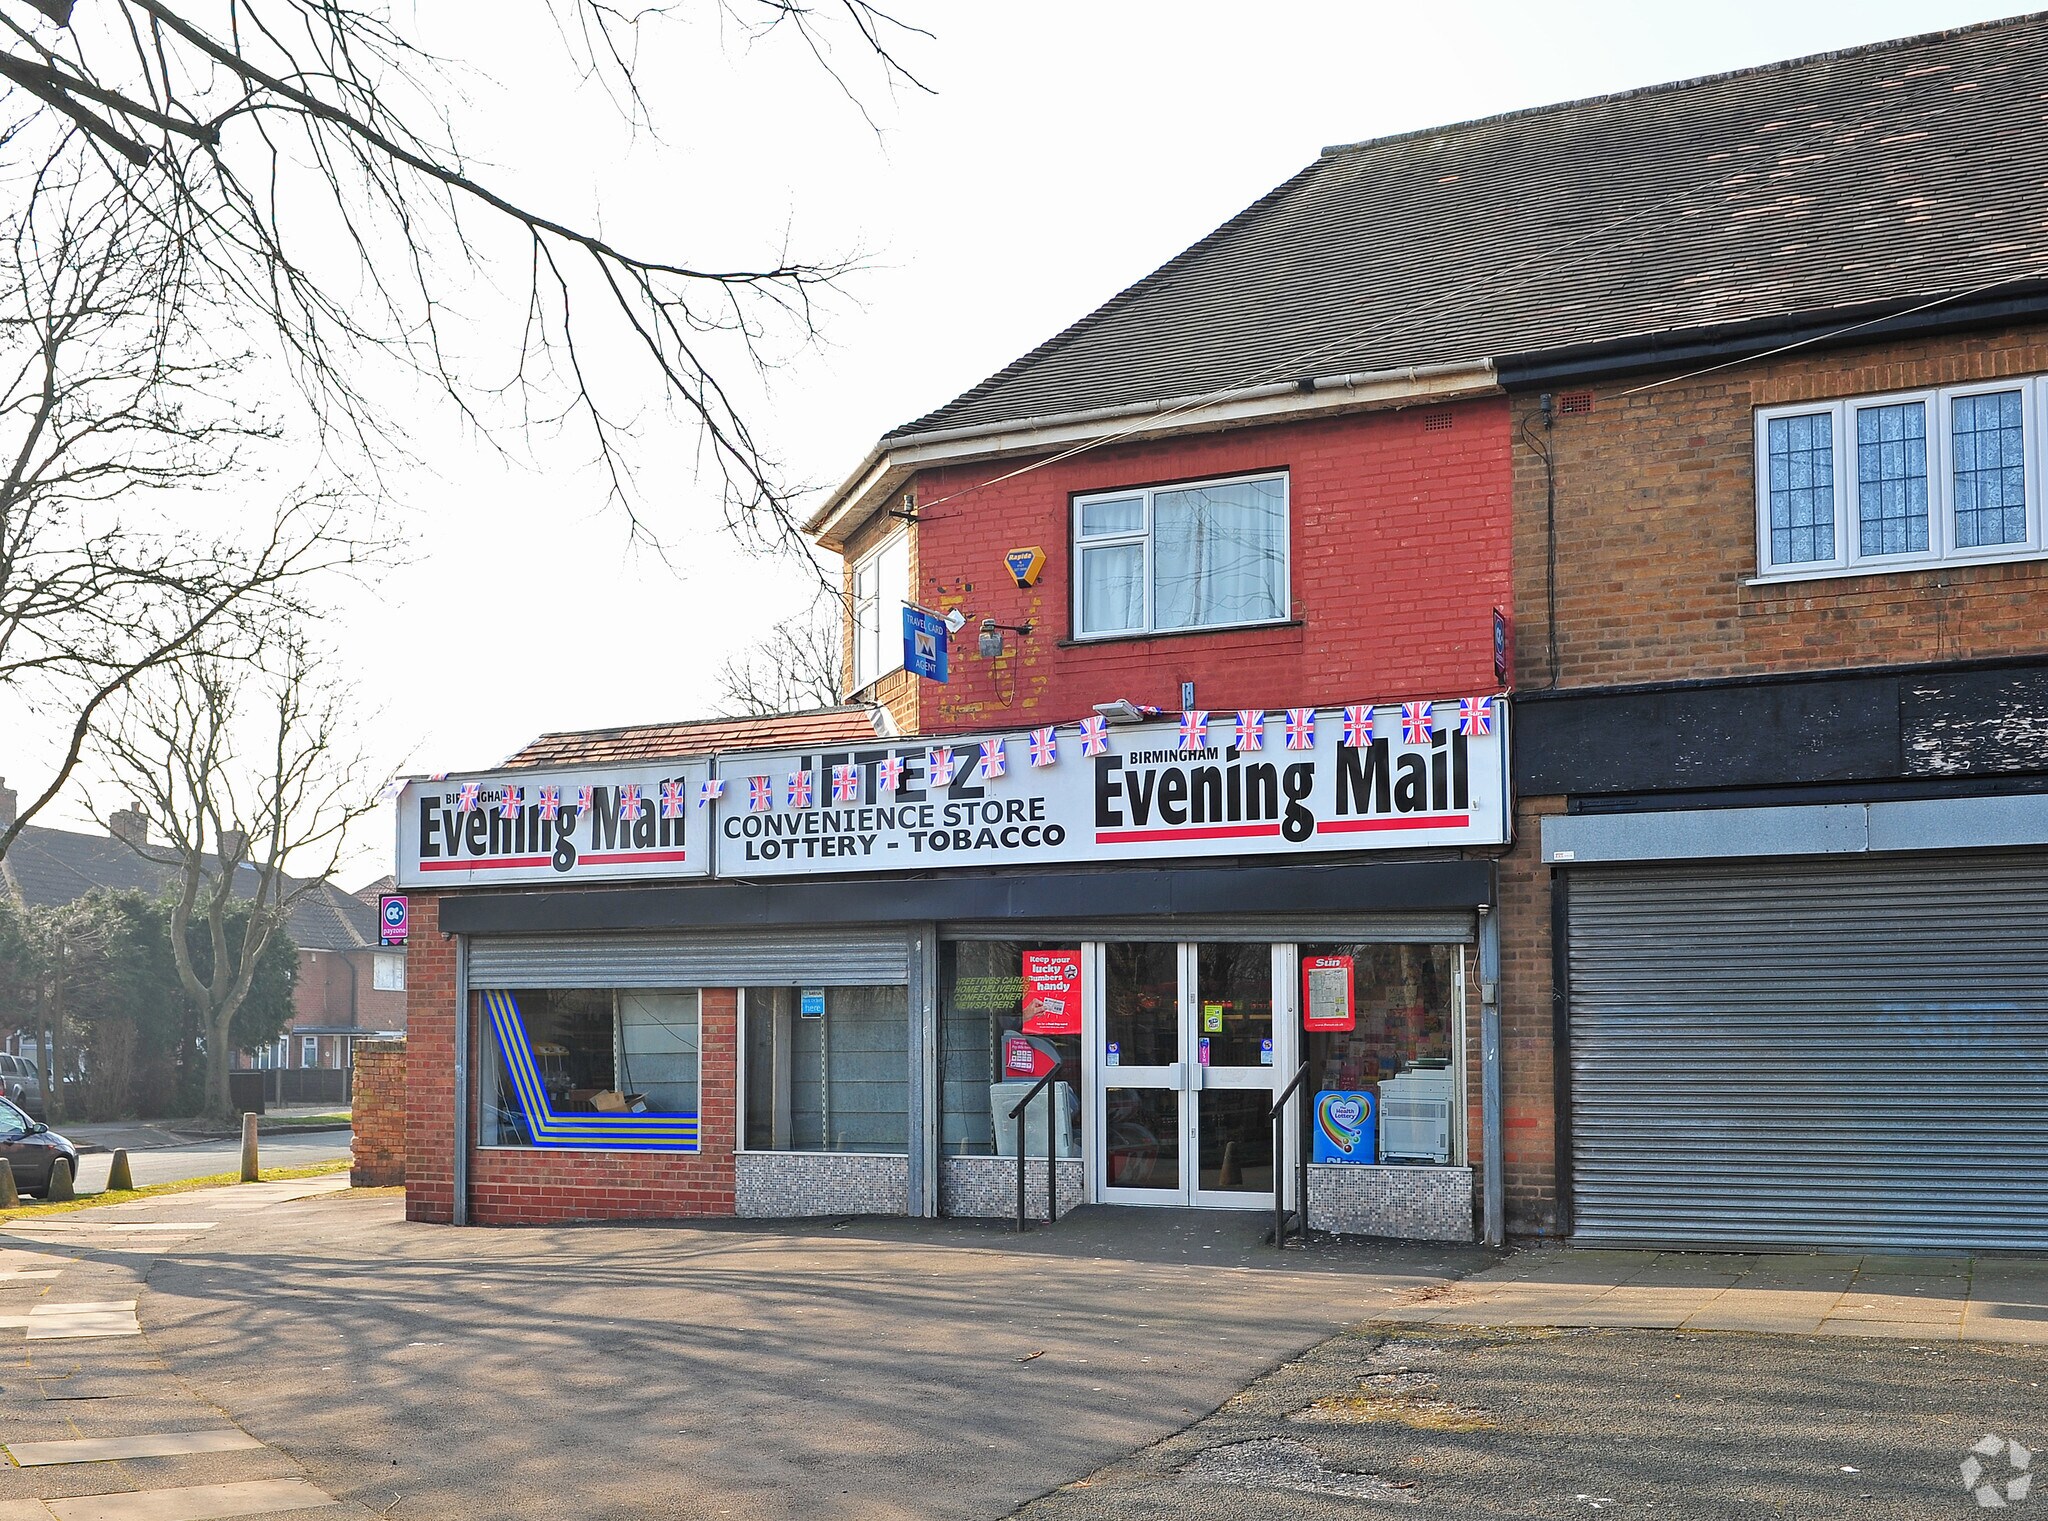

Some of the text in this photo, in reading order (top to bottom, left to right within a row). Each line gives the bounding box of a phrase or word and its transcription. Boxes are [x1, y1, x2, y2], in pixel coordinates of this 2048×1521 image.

[1008, 553, 1032, 561] Rapide
[906, 614, 944, 636] TRAVEL CARD
[915, 659, 937, 673] AGENT
[1129, 747, 1219, 765] BIRMINGHAM
[1095, 727, 1469, 843] Evening Mail
[446, 790, 503, 805] BIRGHA
[724, 797, 1046, 839] CONVENIENCE STORE
[420, 787, 577, 872] Evening
[745, 834, 878, 861] LOTTERY
[909, 824, 1066, 853] TOBACCO
[383, 928, 406, 936] payzone
[1029, 956, 1071, 965] Keep your
[1315, 958, 1341, 967] Sun
[1032, 964, 1061, 974] lucky
[1002, 976, 1031, 984] CARDS
[954, 984, 1030, 993] HOME DELIVERIES
[1037, 982, 1071, 992] handy
[953, 993, 1028, 1001] CONFECTIONERY
[954, 1001, 1016, 1009] NEWSPAPERS
